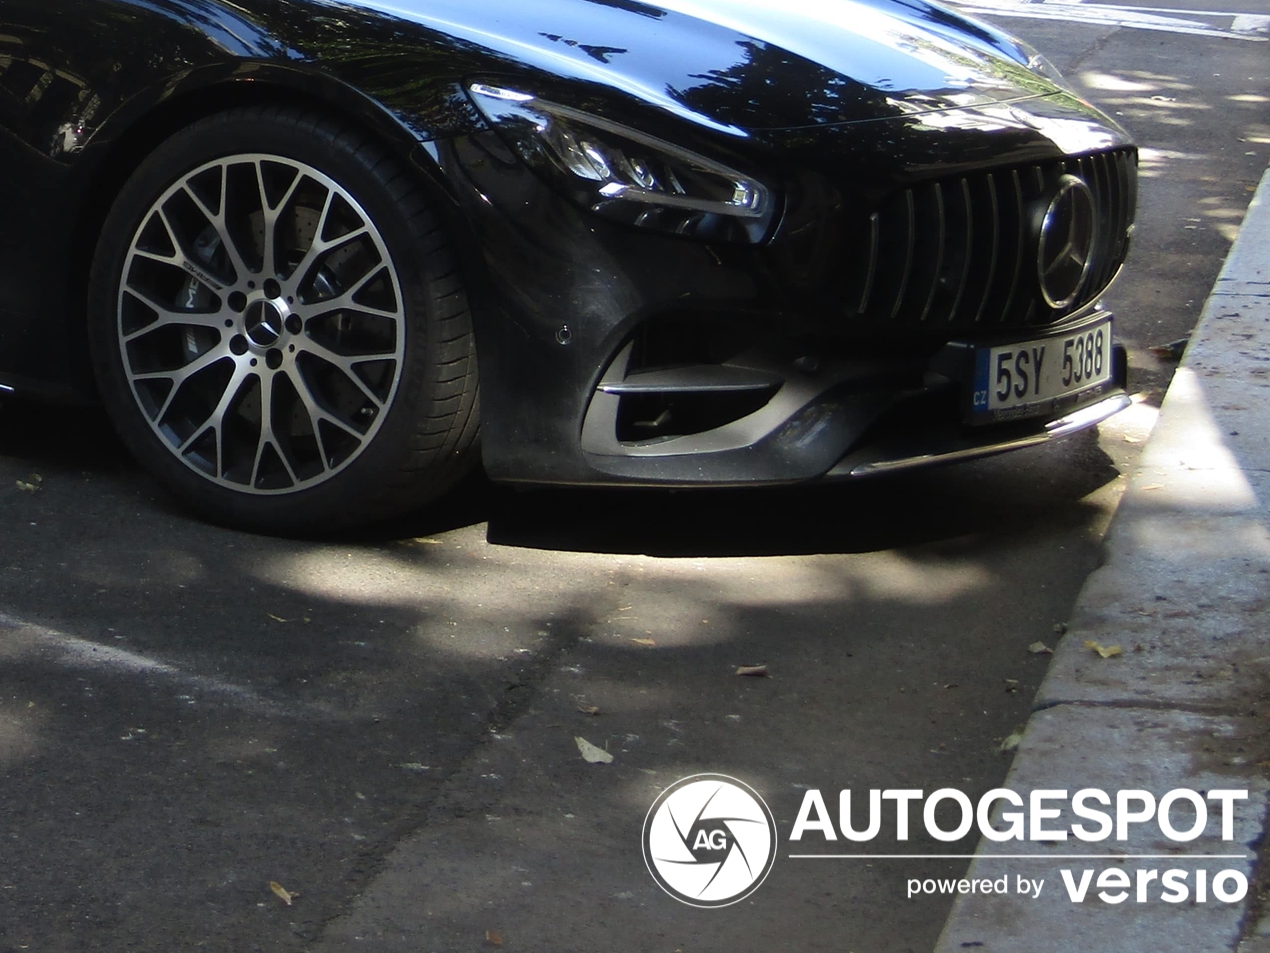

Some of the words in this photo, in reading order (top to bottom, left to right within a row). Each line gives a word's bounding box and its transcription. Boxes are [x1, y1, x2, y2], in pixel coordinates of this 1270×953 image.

[996, 346, 1045, 401] 5SY
[1062, 329, 1103, 387] 5388
[973, 390, 986, 405] CZ
